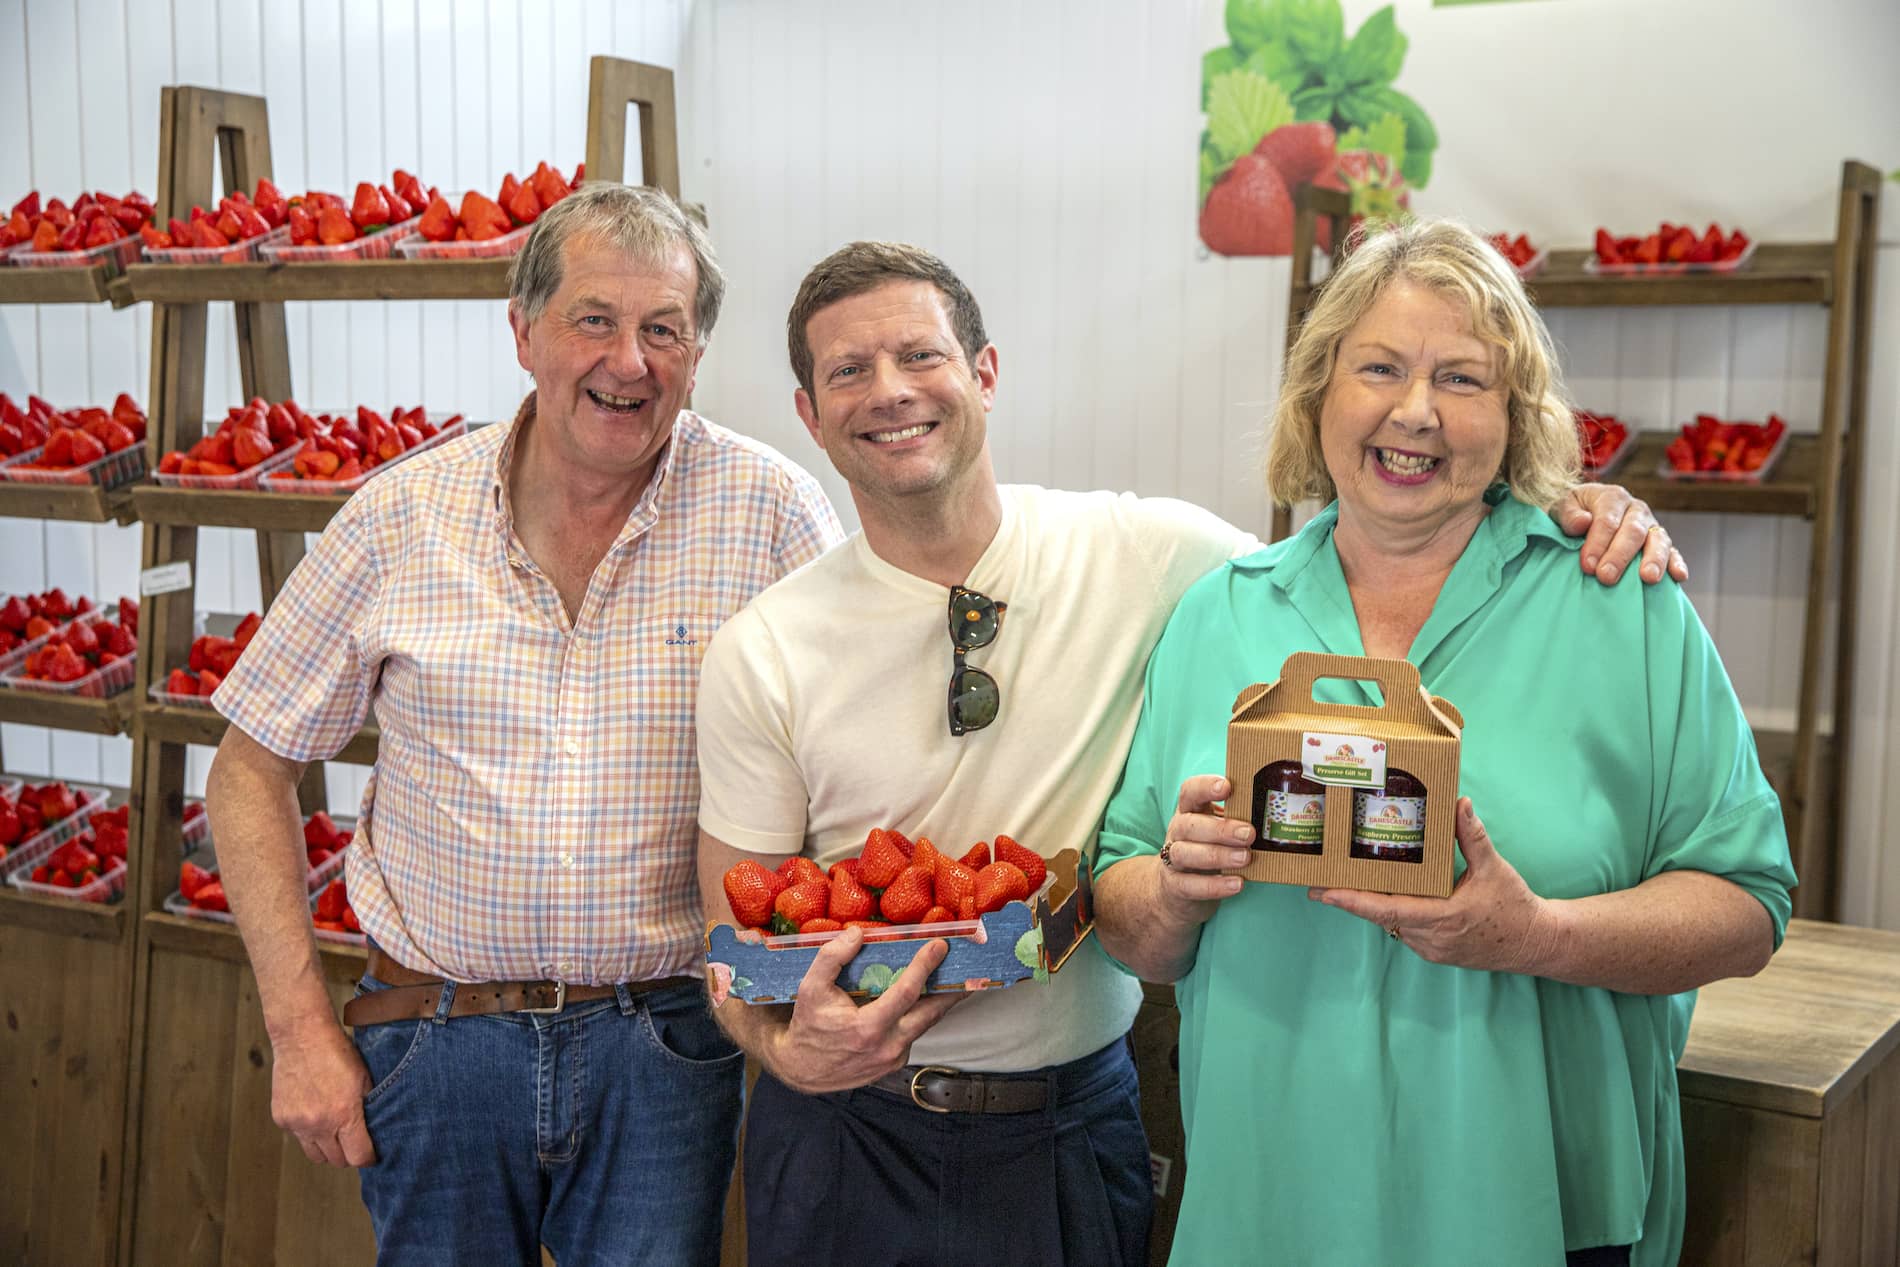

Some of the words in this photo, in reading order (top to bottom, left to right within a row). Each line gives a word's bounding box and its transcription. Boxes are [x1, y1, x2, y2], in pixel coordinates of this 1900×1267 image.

[1317, 766, 1344, 775] Preserve
[1345, 768, 1356, 776] Gift
[1369, 816, 1413, 825] DANESCASTLE
